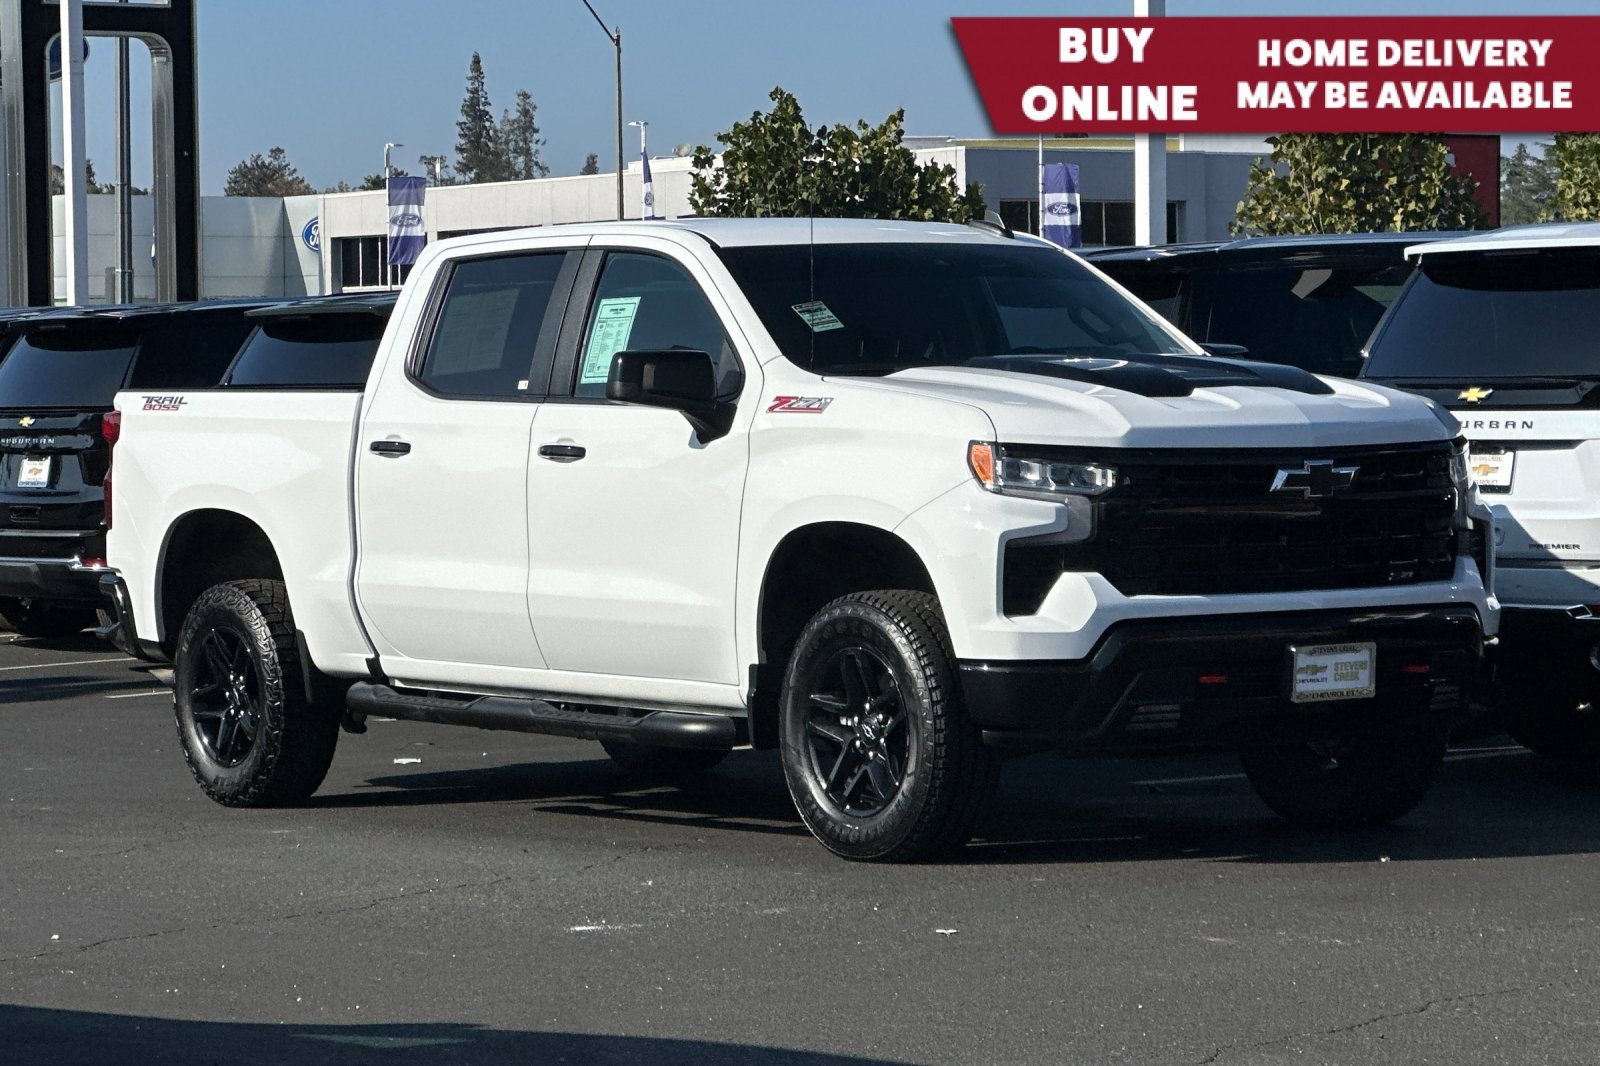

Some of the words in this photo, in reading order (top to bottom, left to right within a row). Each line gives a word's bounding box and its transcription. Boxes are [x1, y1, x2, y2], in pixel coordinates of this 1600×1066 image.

[141, 396, 188, 404] TRAIL
[766, 396, 834, 414] Z71
[1528, 543, 1581, 551] PREMIER
[1334, 660, 1368, 671] STEVENS
[1334, 671, 1360, 682] CREEK
[1311, 690, 1356, 699] CHEVROLET
